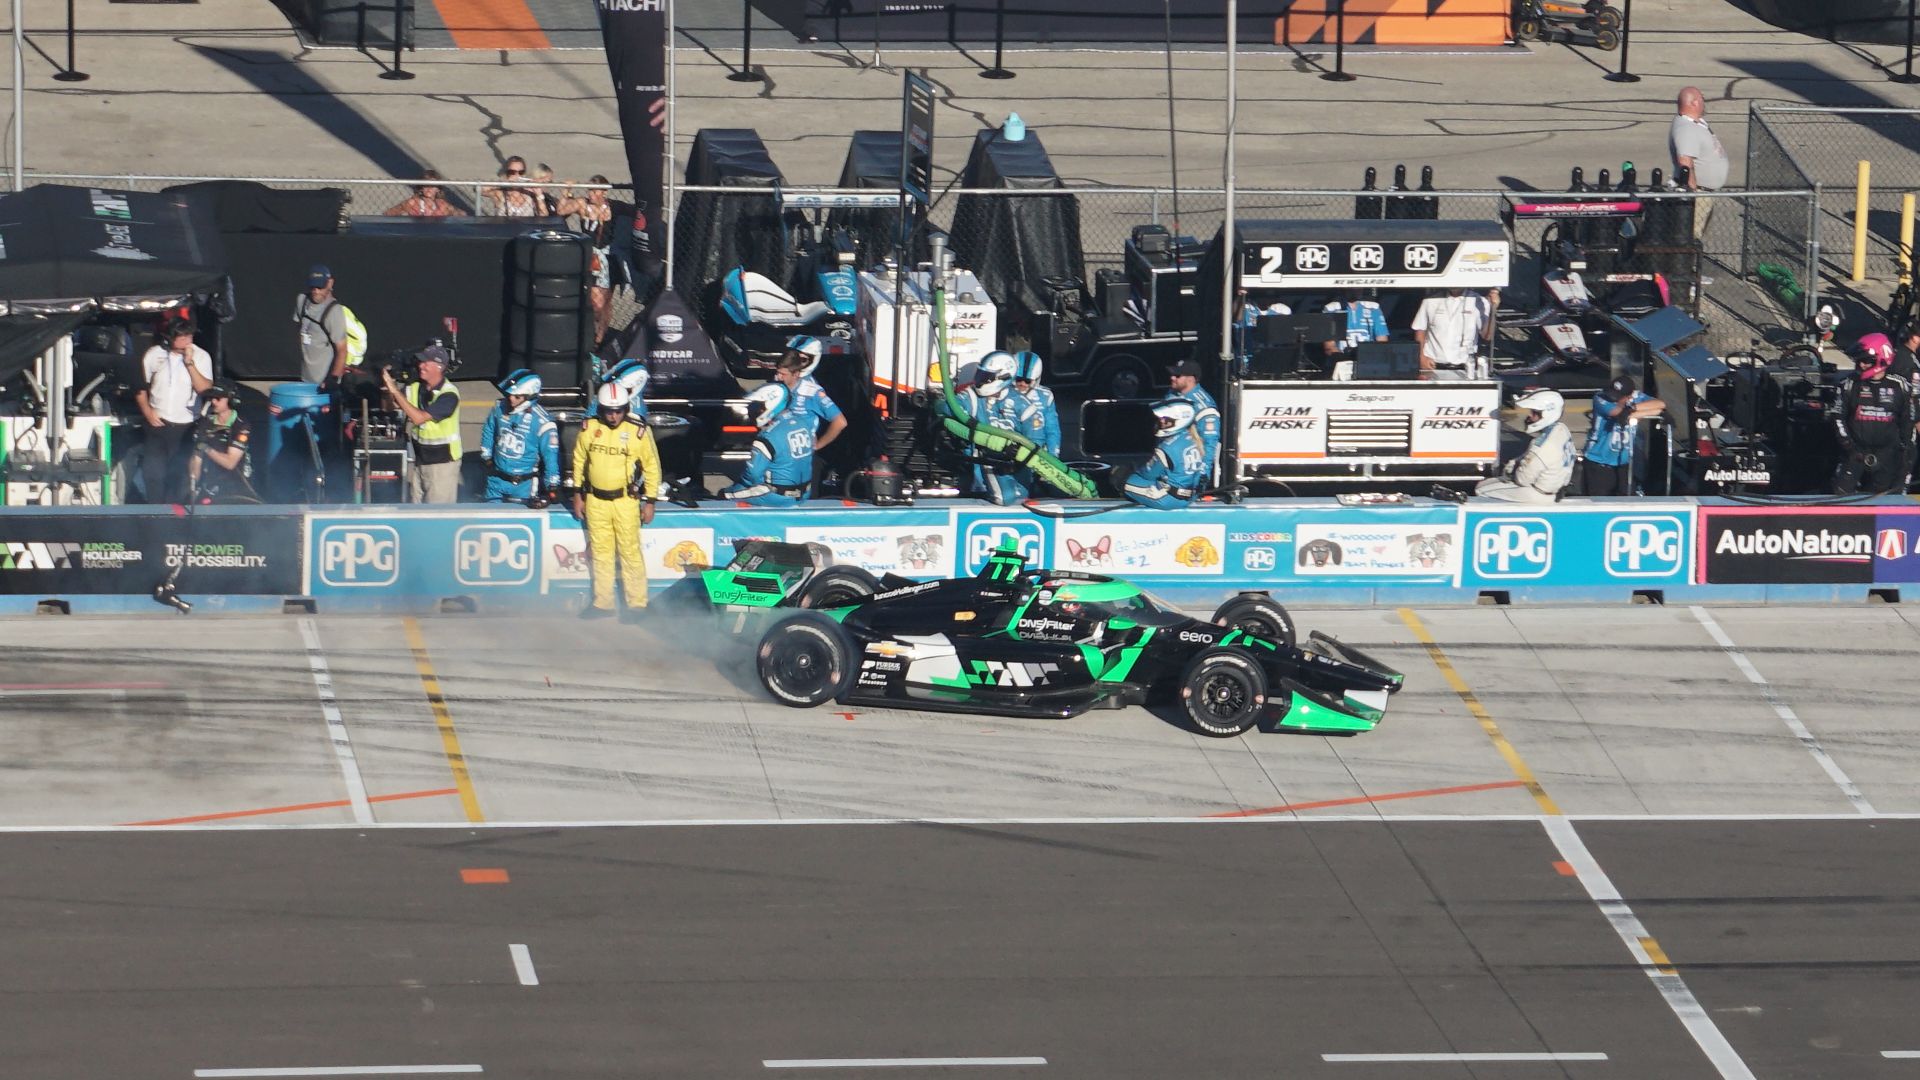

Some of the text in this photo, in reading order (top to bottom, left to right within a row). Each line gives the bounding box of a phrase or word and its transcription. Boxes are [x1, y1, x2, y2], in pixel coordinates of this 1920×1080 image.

[1298, 246, 1329, 269] PPG
[1352, 246, 1382, 269] PPG
[1406, 246, 1436, 269] PPG
[1261, 247, 1282, 282] 2
[1334, 278, 1396, 286] NEWGARDEN
[1346, 393, 1395, 402] Snap-on
[1263, 406, 1312, 416] TEAM
[1435, 406, 1485, 416] TEAM
[1248, 419, 1318, 430] PENSKE
[1420, 419, 1490, 430] PENSKE
[589, 443, 631, 456] OFFICIAL
[83, 542, 125, 551] JUNCOS
[1479, 525, 1547, 571] PPG
[1610, 523, 1678, 570] PPG
[1715, 529, 1873, 554] AutoNation
[83, 551, 143, 561] HOLLINGER
[194, 544, 244, 556] POWER
[325, 532, 393, 579] PPG
[460, 531, 529, 578] PPG
[83, 560, 124, 568] RACING
[188, 555, 267, 567] POSSIBILITY.
[1247, 549, 1273, 568] PPG
[1180, 630, 1213, 643] eero
